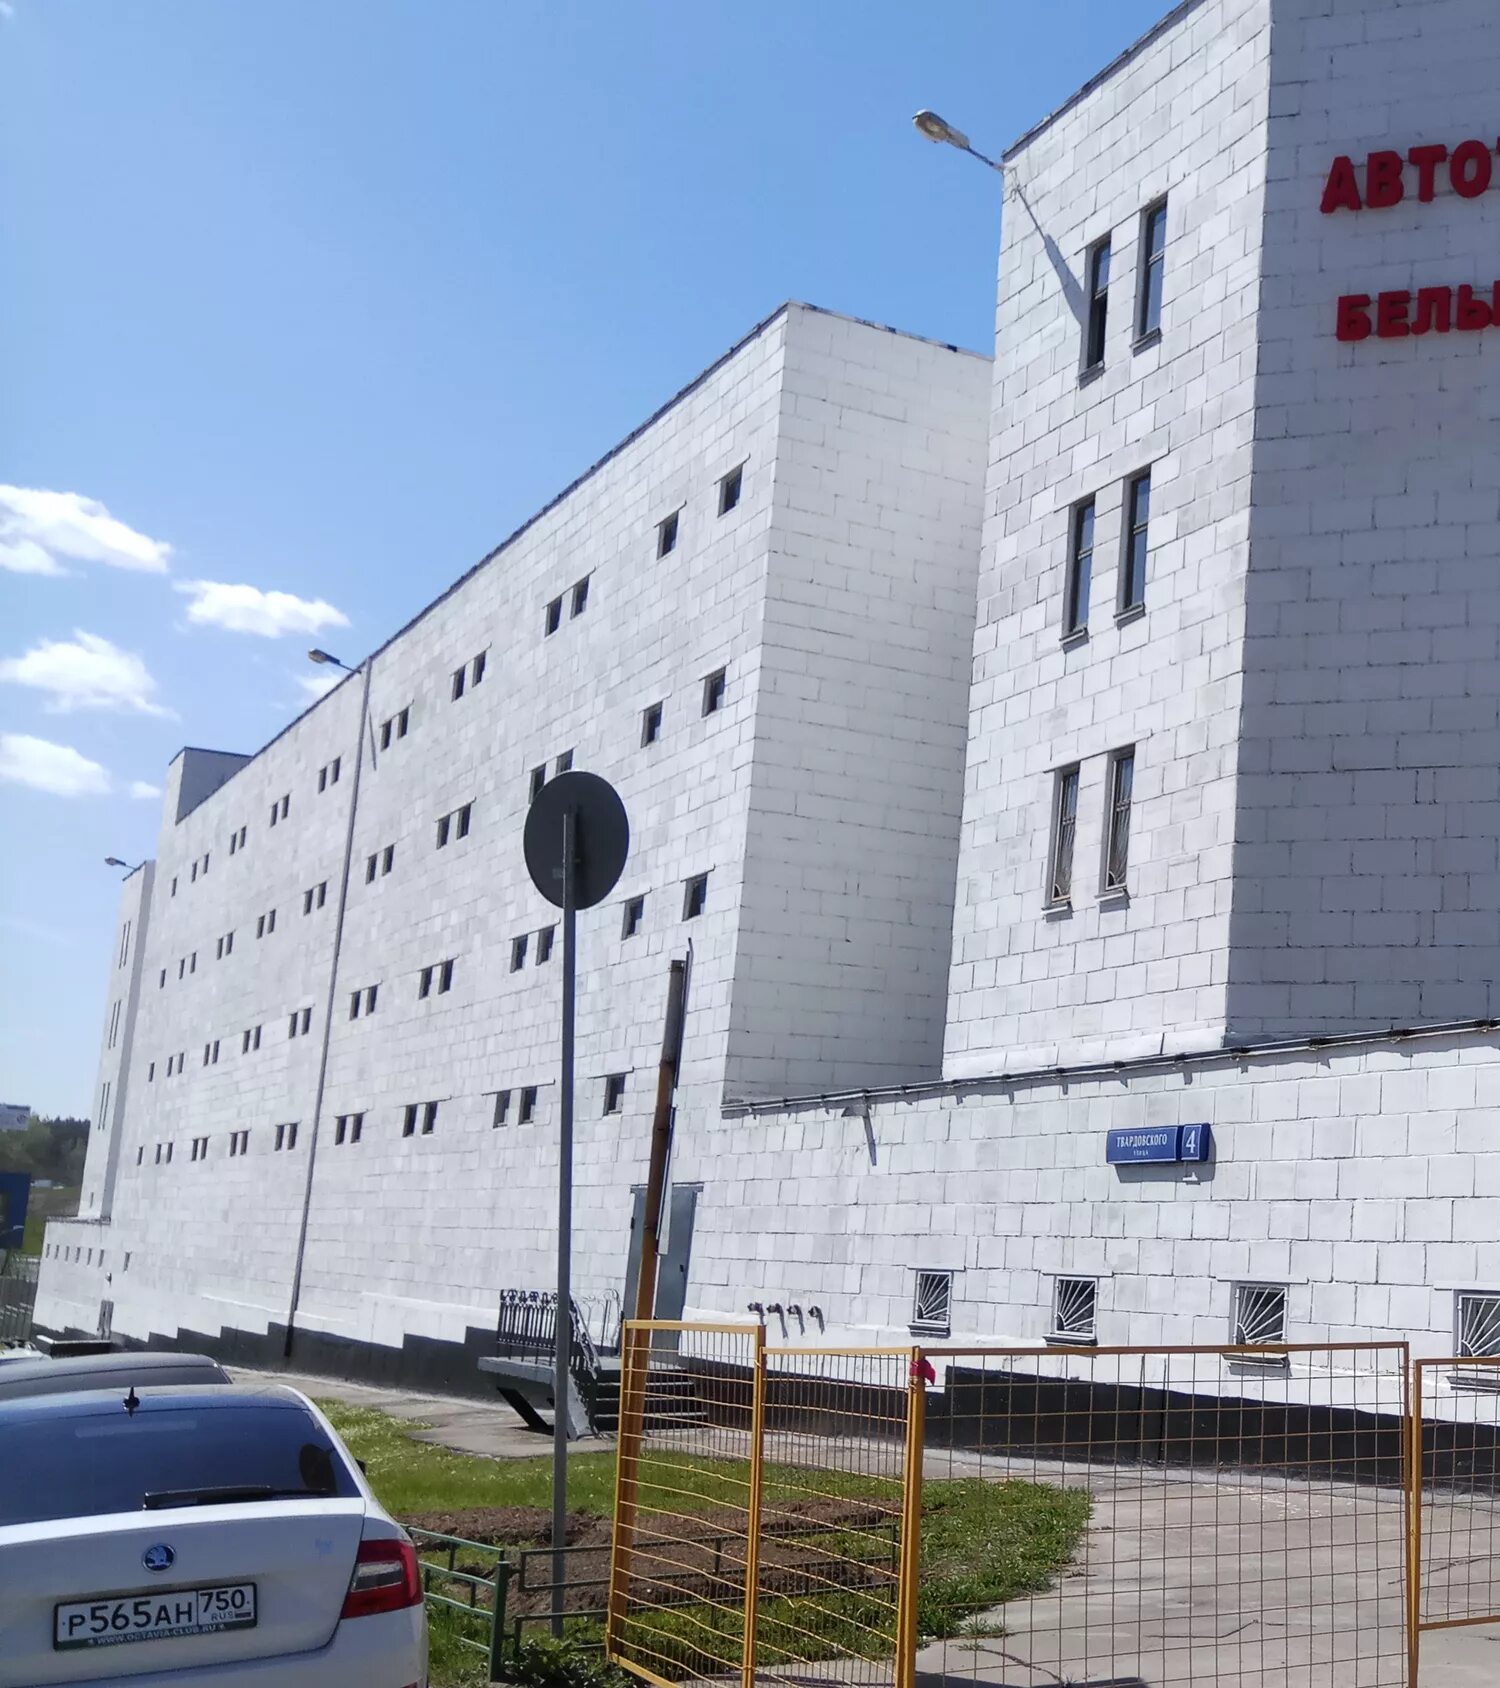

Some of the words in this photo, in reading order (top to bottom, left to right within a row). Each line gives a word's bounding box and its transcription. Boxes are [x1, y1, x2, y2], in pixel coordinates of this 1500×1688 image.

[1116, 1133, 1168, 1148] ТВАРДОВСКОГО
[1186, 1129, 1196, 1154] 4
[200, 1589, 245, 1613] 750
[211, 1610, 233, 1622] RUS
